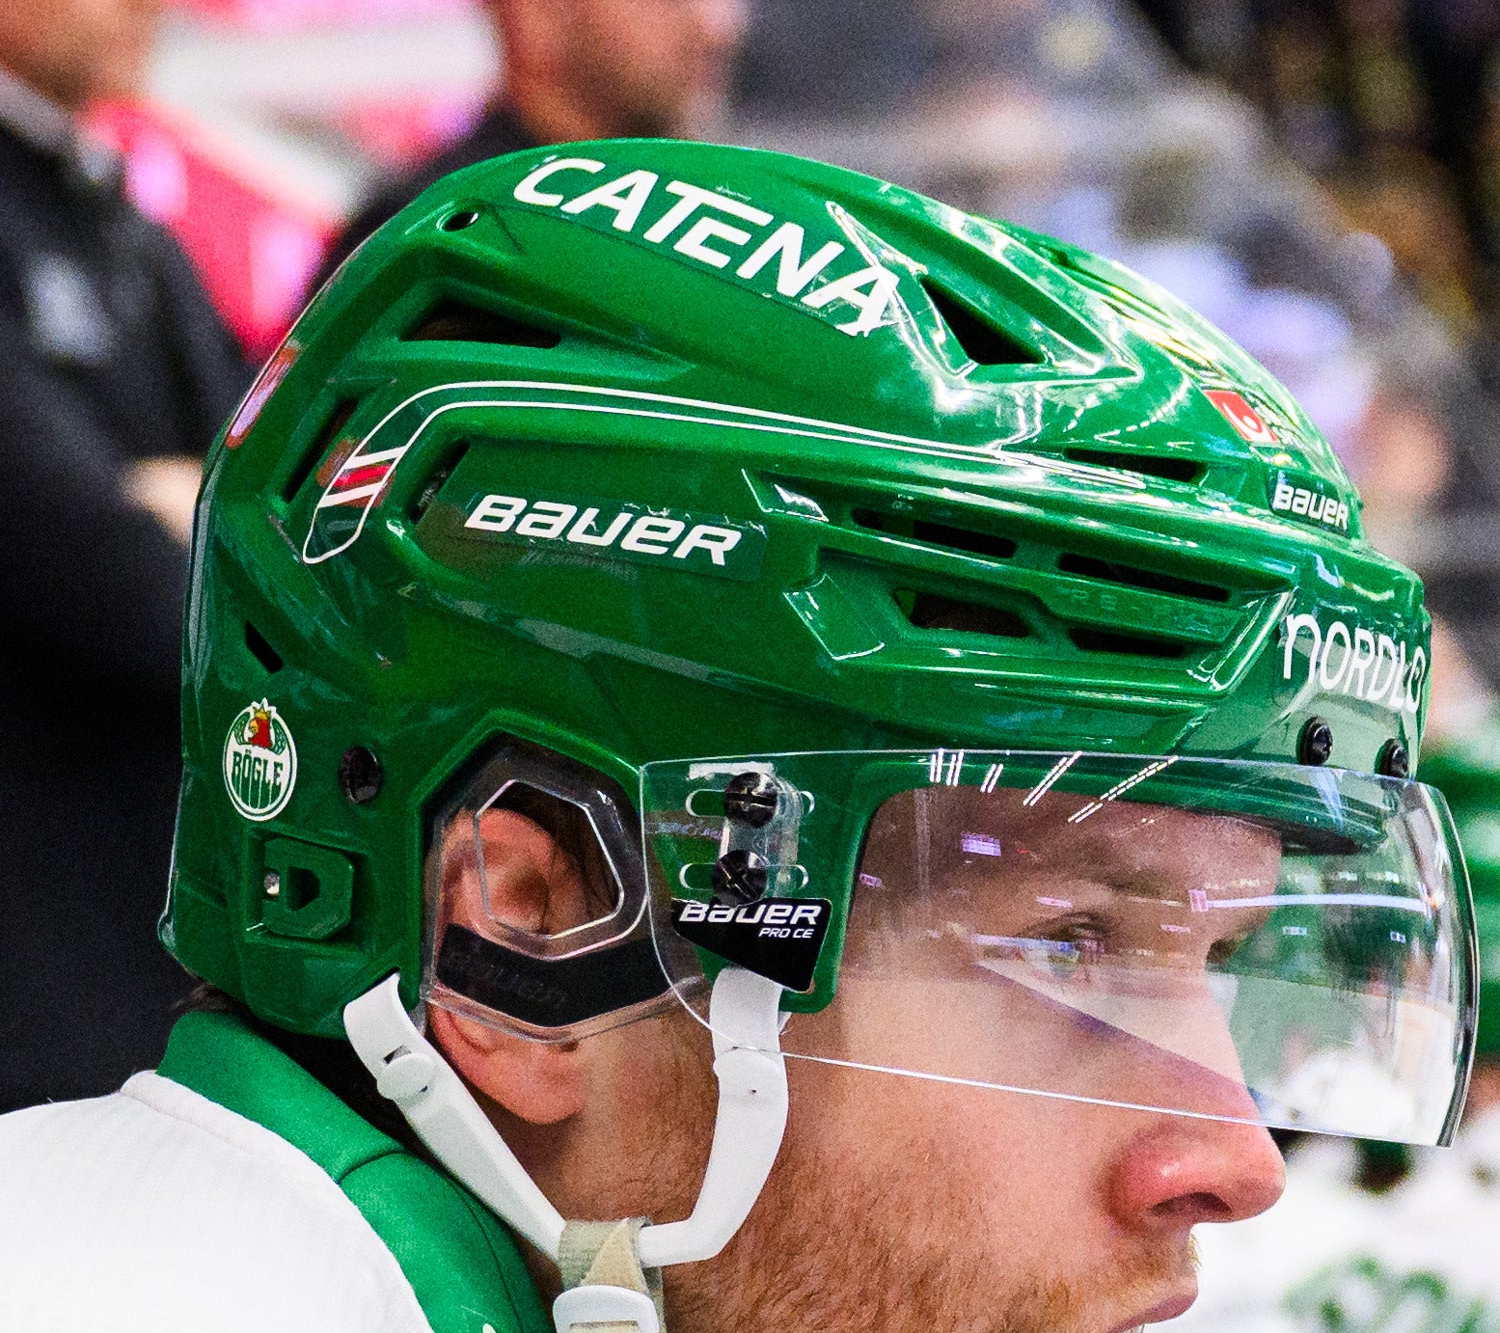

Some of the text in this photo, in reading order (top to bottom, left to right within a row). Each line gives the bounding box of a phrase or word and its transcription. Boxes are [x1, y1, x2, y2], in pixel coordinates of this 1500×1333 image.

[512, 157, 901, 337] CATENA
[1273, 482, 1349, 531] BAUER
[464, 494, 742, 566] BAUER
[231, 749, 284, 792] RÖGLE
[678, 903, 822, 925] BAUER
[758, 927, 815, 939] PRO CE
